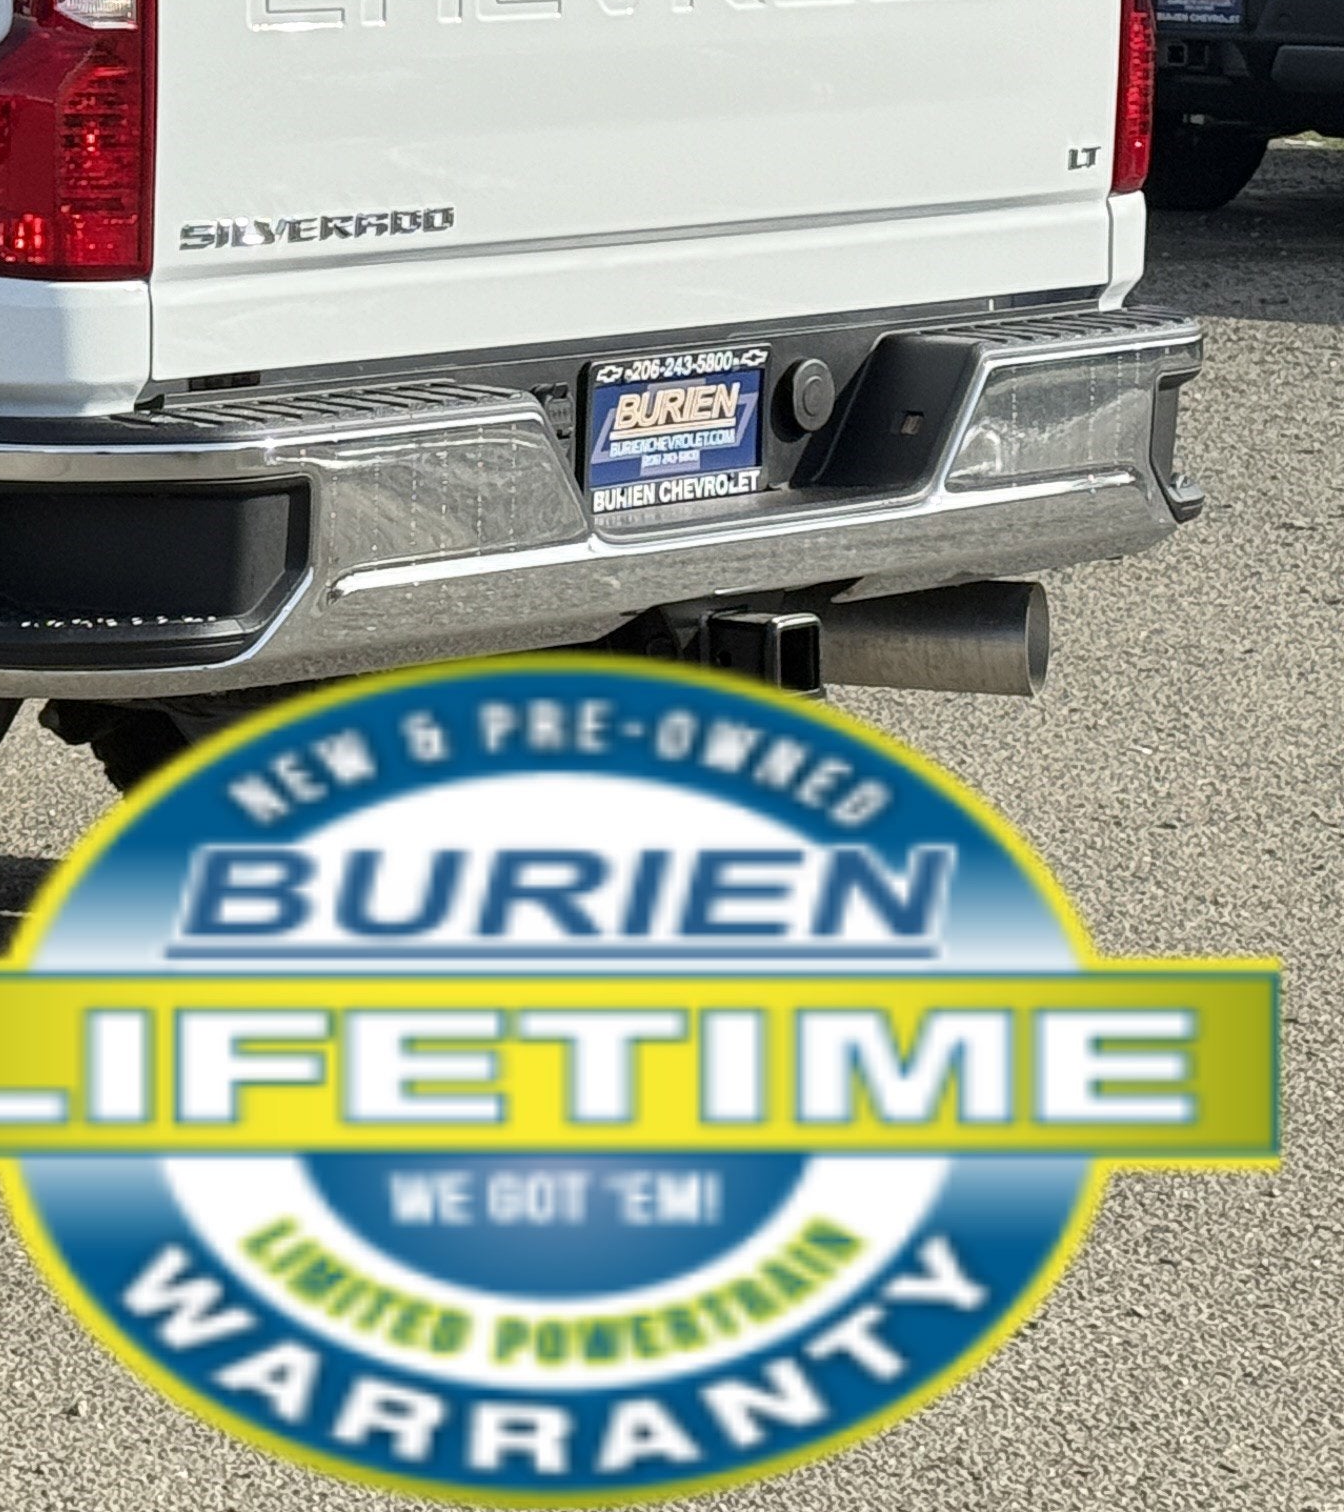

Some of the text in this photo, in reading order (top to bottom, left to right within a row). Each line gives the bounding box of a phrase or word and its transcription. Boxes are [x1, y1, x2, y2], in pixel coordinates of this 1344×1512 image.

[1068, 146, 1101, 170] LT
[179, 206, 455, 251] SILVERADO
[615, 383, 740, 429] BURIEN
[609, 428, 736, 458] BURIENCHEVROLET.COM
[593, 470, 760, 513] BURIEN CHEVROLET
